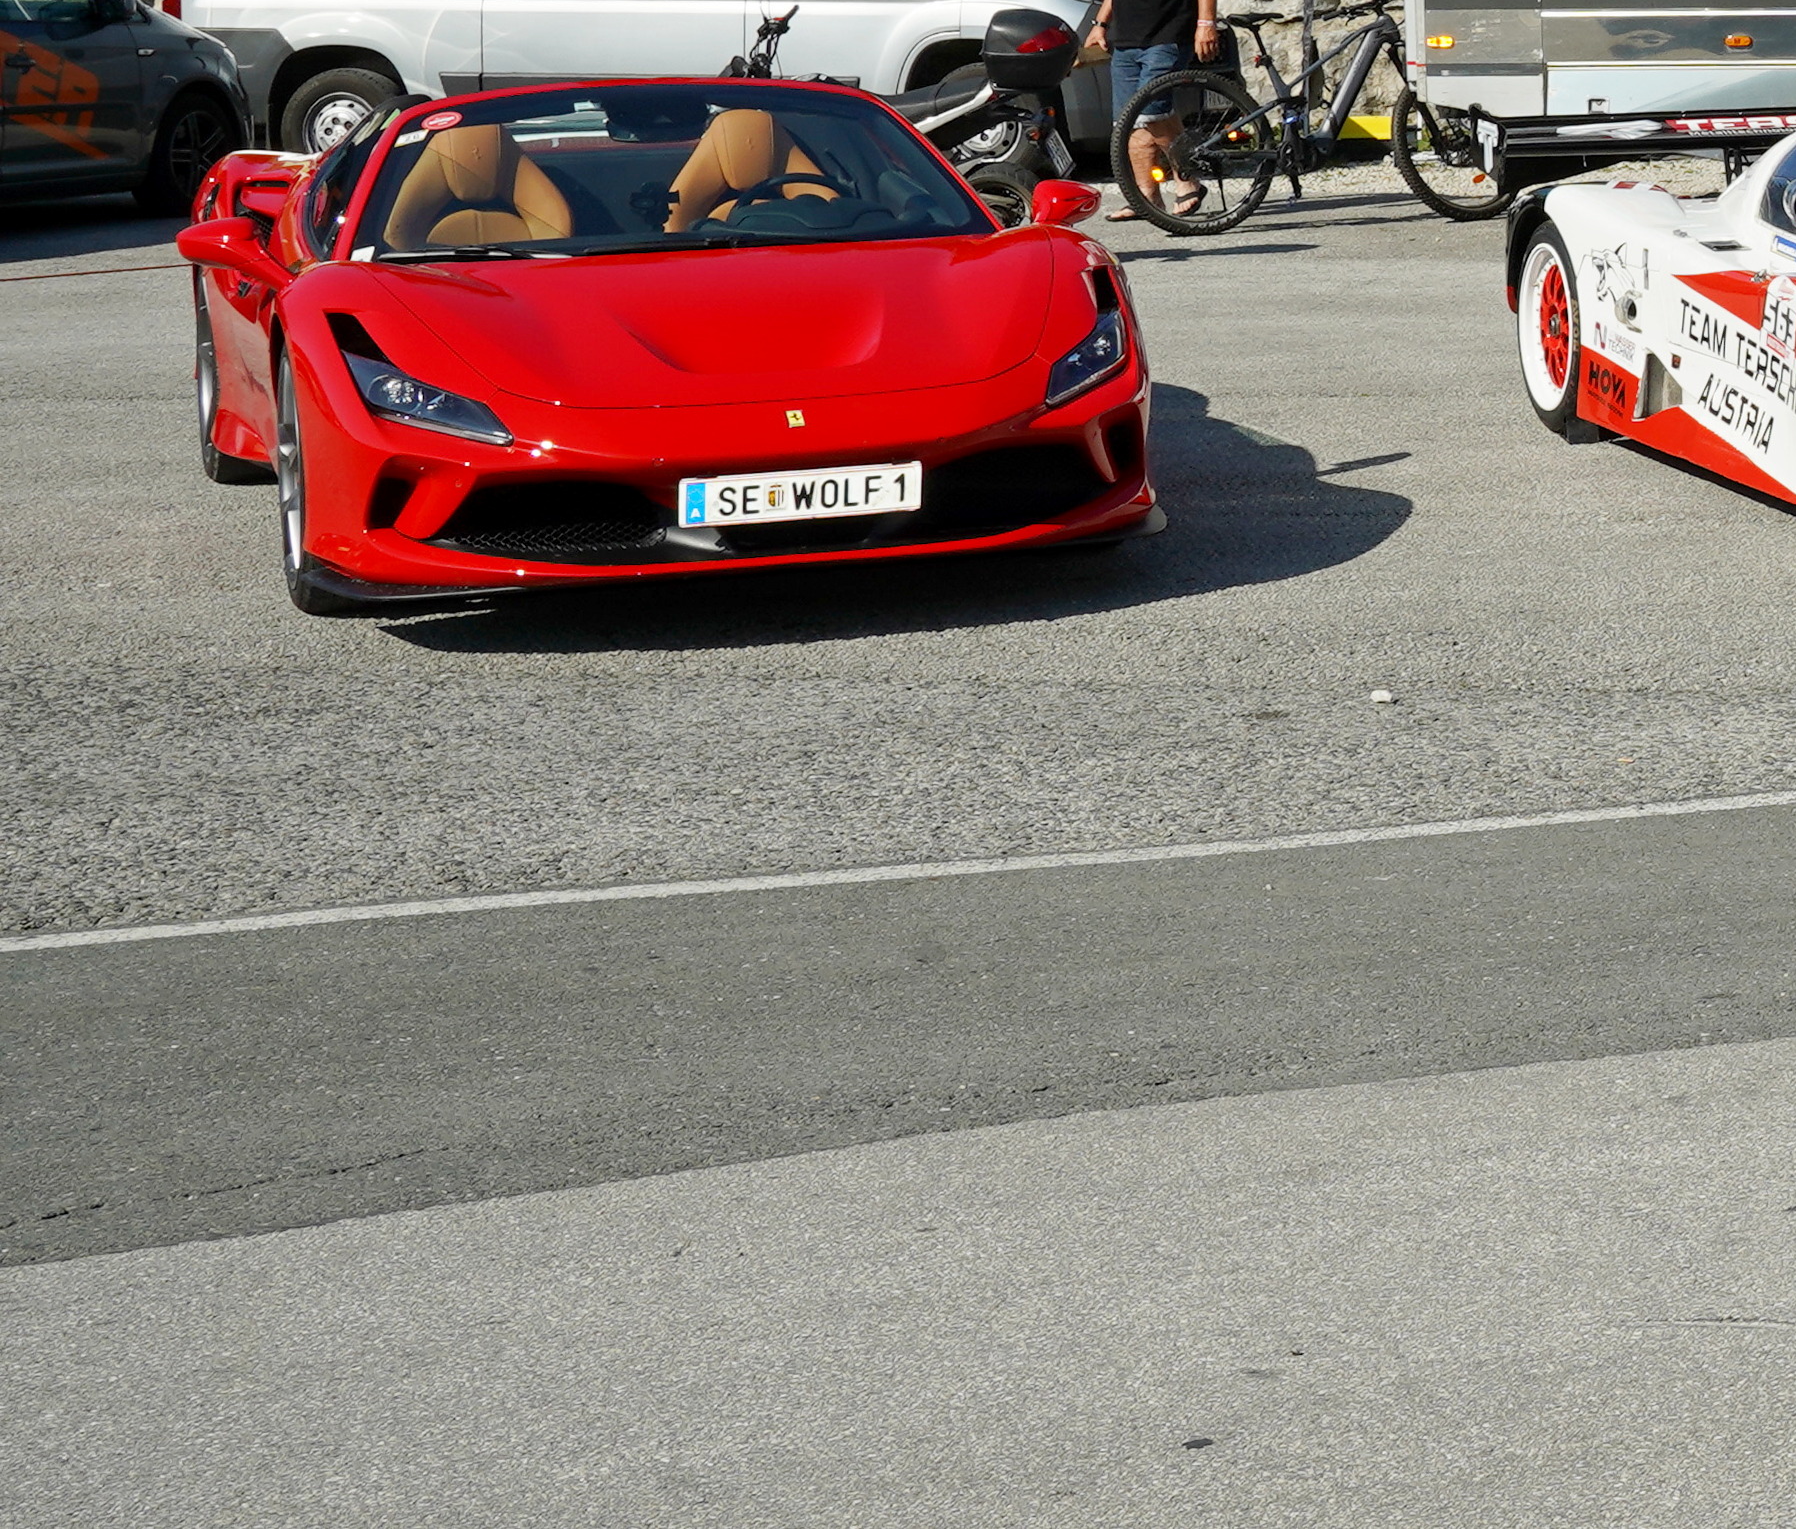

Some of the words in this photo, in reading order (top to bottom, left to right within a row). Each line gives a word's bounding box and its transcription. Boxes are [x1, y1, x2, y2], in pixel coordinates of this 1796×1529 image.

[1680, 298, 1728, 358] TEAM
[1588, 360, 1626, 409] HOVA
[1698, 373, 1775, 454] AUSTRIA
[718, 485, 761, 516] SE
